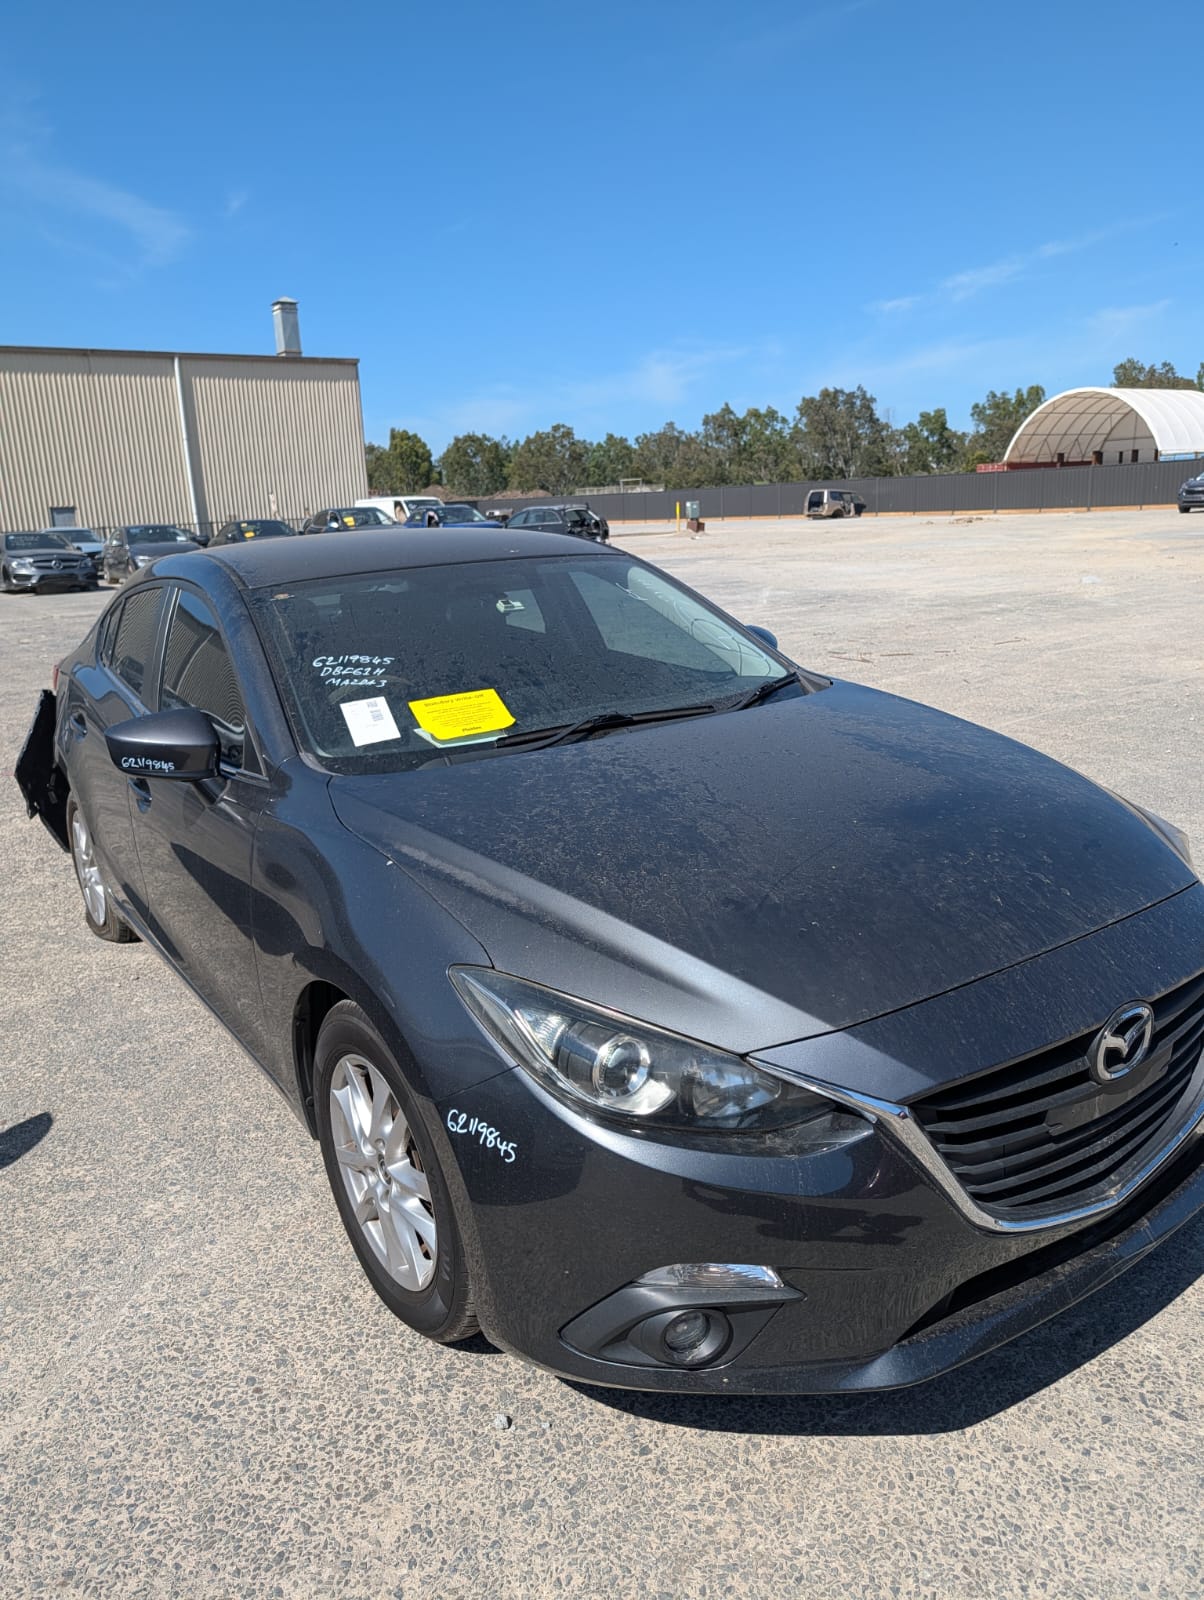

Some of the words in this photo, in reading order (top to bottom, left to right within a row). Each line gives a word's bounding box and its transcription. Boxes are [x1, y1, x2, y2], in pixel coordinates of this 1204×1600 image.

[312, 654, 395, 668] 62119845
[121, 756, 176, 773] 62119845
[447, 1108, 518, 1164] 62119845
